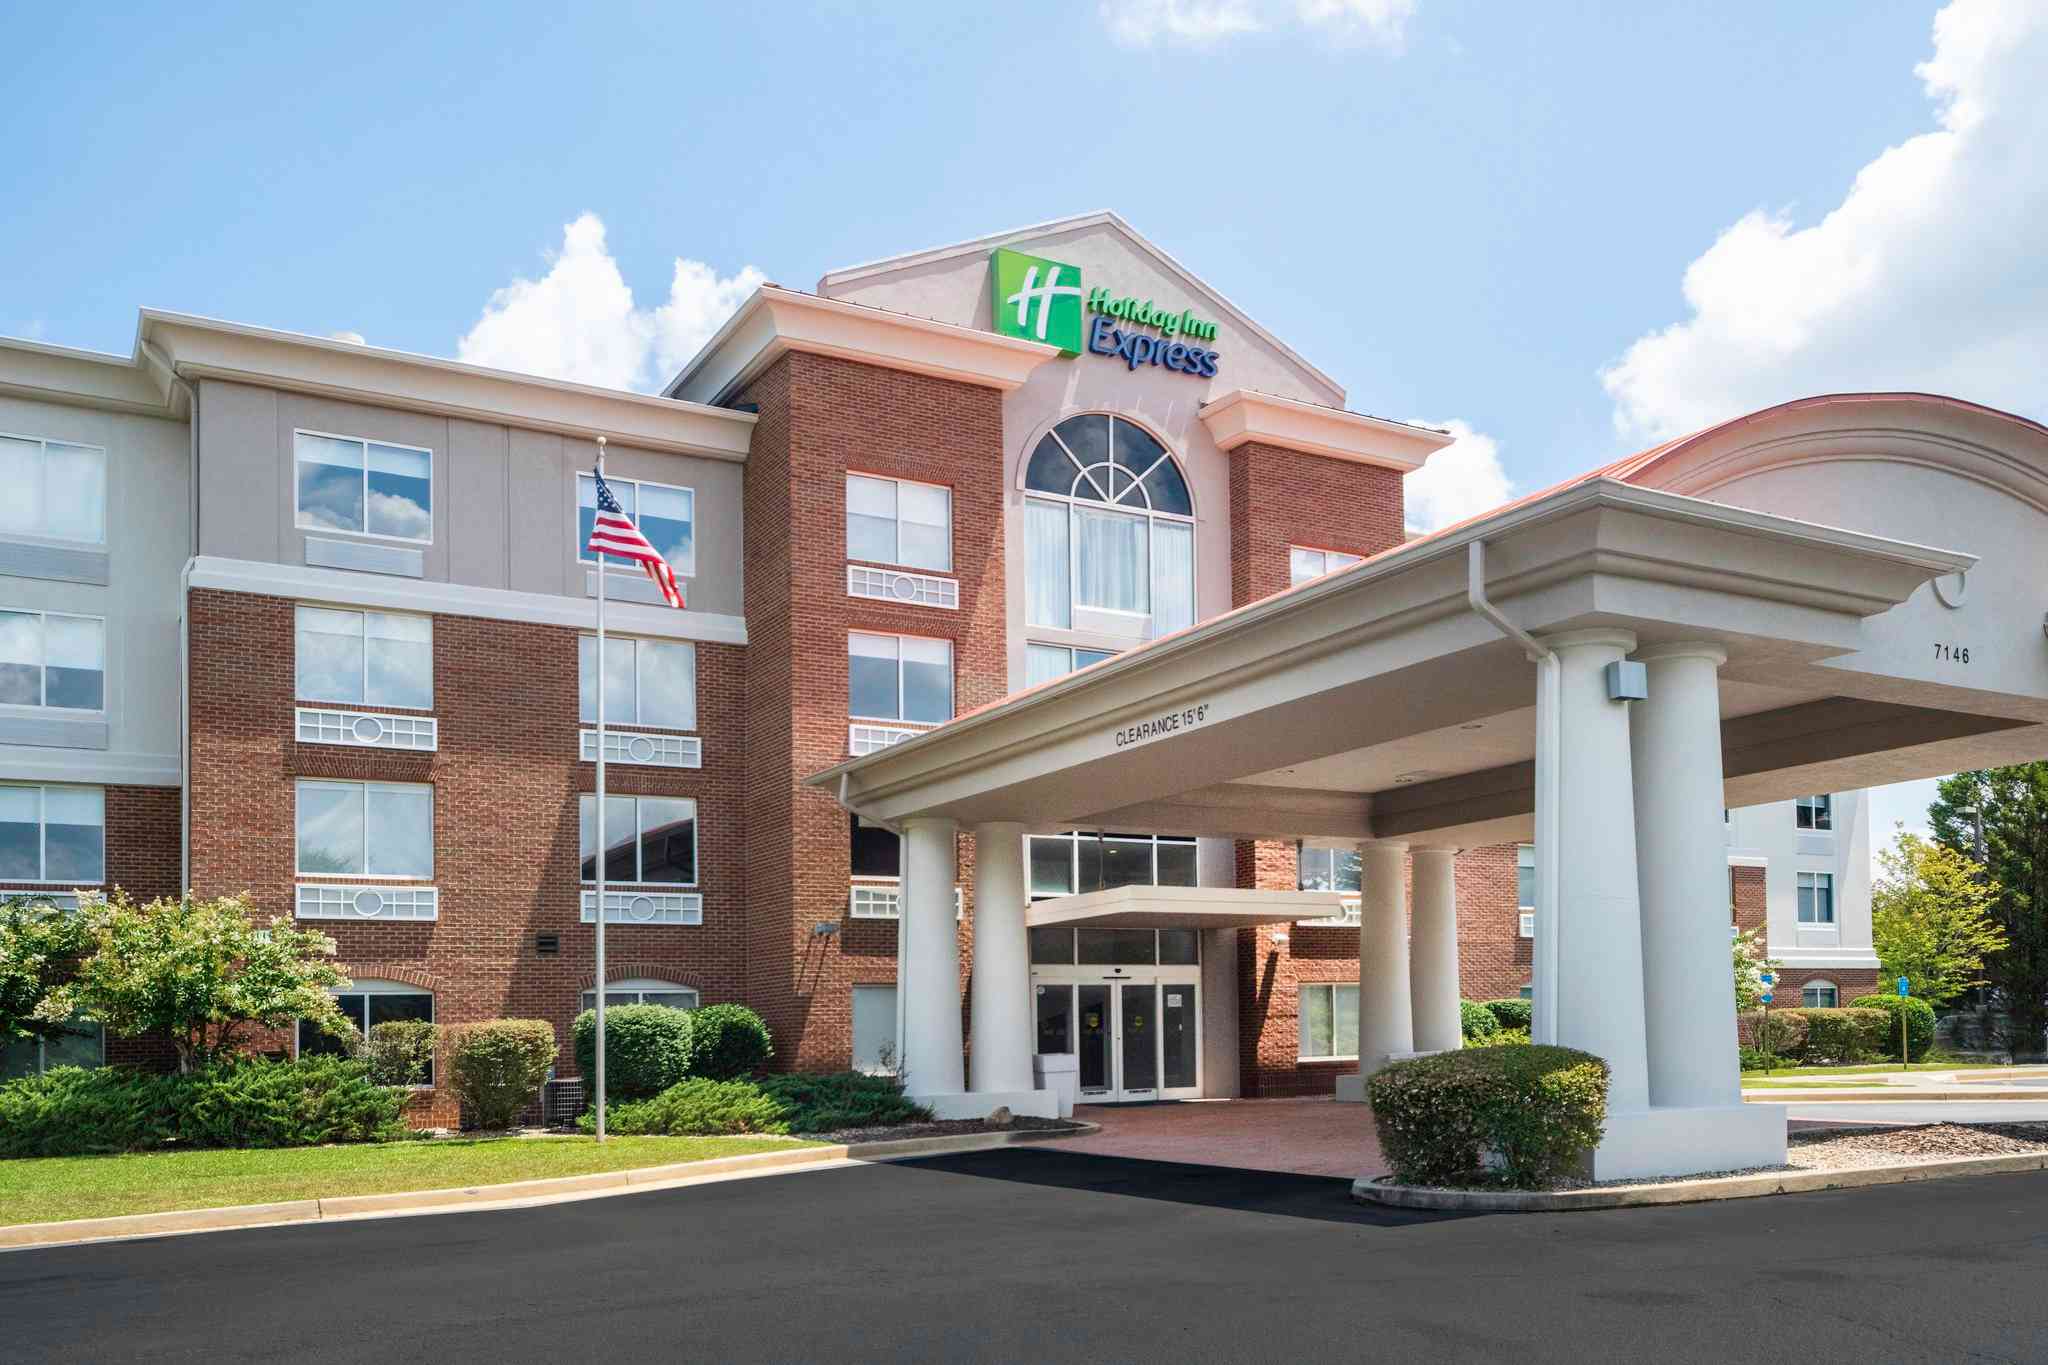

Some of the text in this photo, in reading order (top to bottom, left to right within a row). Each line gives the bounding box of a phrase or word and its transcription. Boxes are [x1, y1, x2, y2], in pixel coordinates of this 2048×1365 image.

[1087, 287, 1217, 342] Holiday Inn
[1089, 316, 1220, 378] Express
[1934, 643, 1969, 664] 7146
[1116, 713, 1179, 746] CLEARANCE
